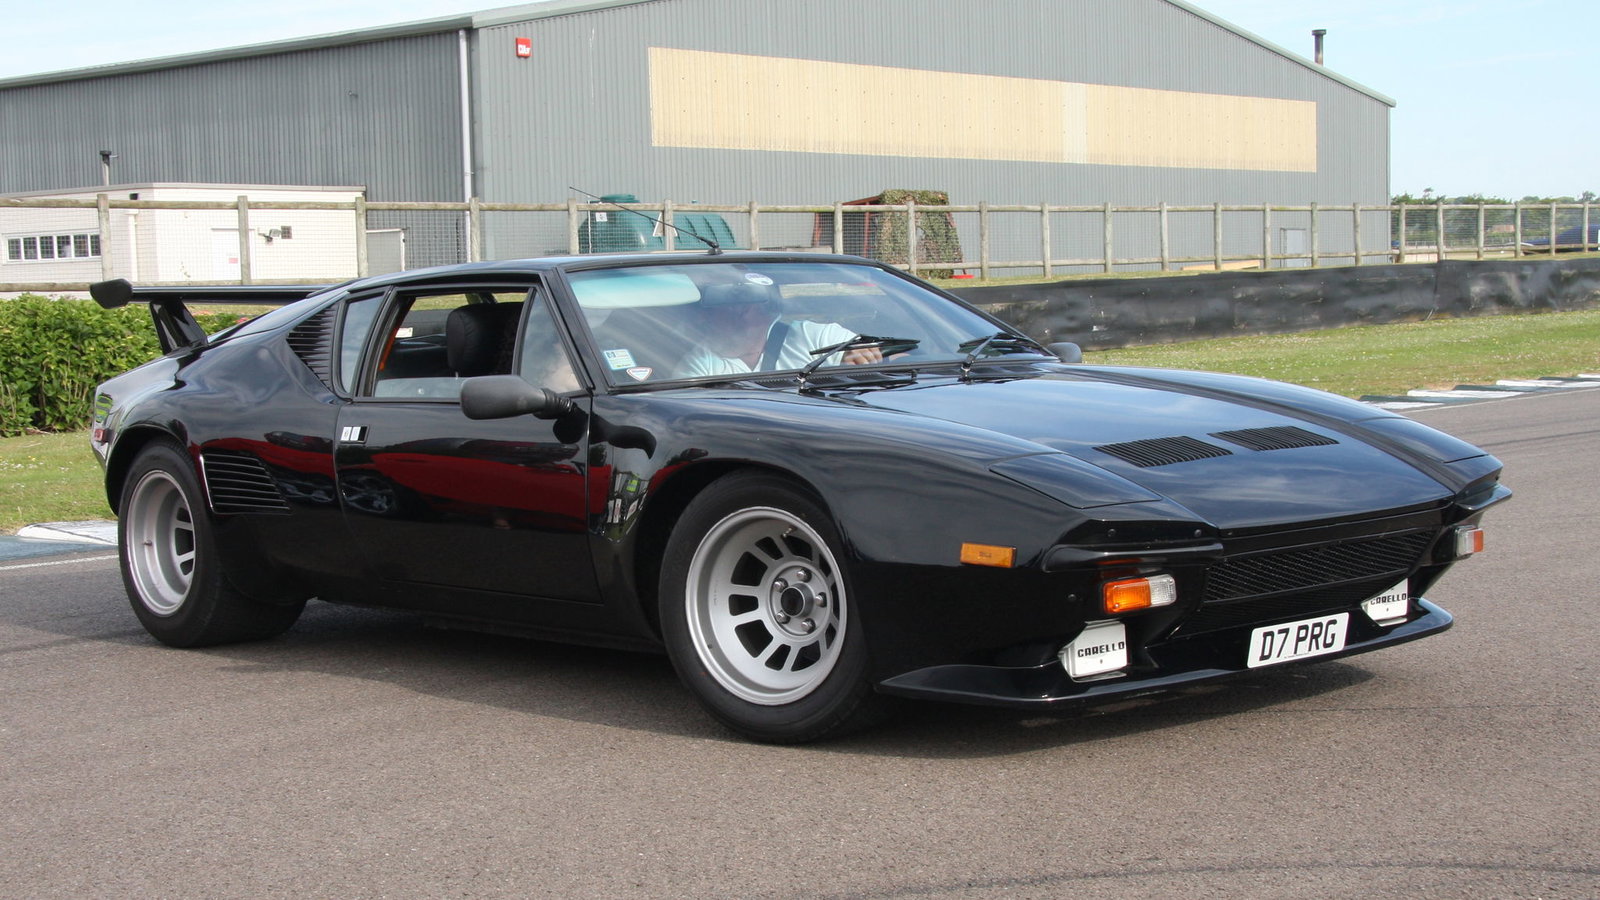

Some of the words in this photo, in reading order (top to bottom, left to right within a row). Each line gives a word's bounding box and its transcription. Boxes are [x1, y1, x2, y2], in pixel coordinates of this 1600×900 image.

[1370, 593, 1407, 605] CARELLO
[1259, 627, 1290, 661] D7
[1294, 619, 1337, 654] PRG
[1077, 641, 1125, 658] CARELLO
